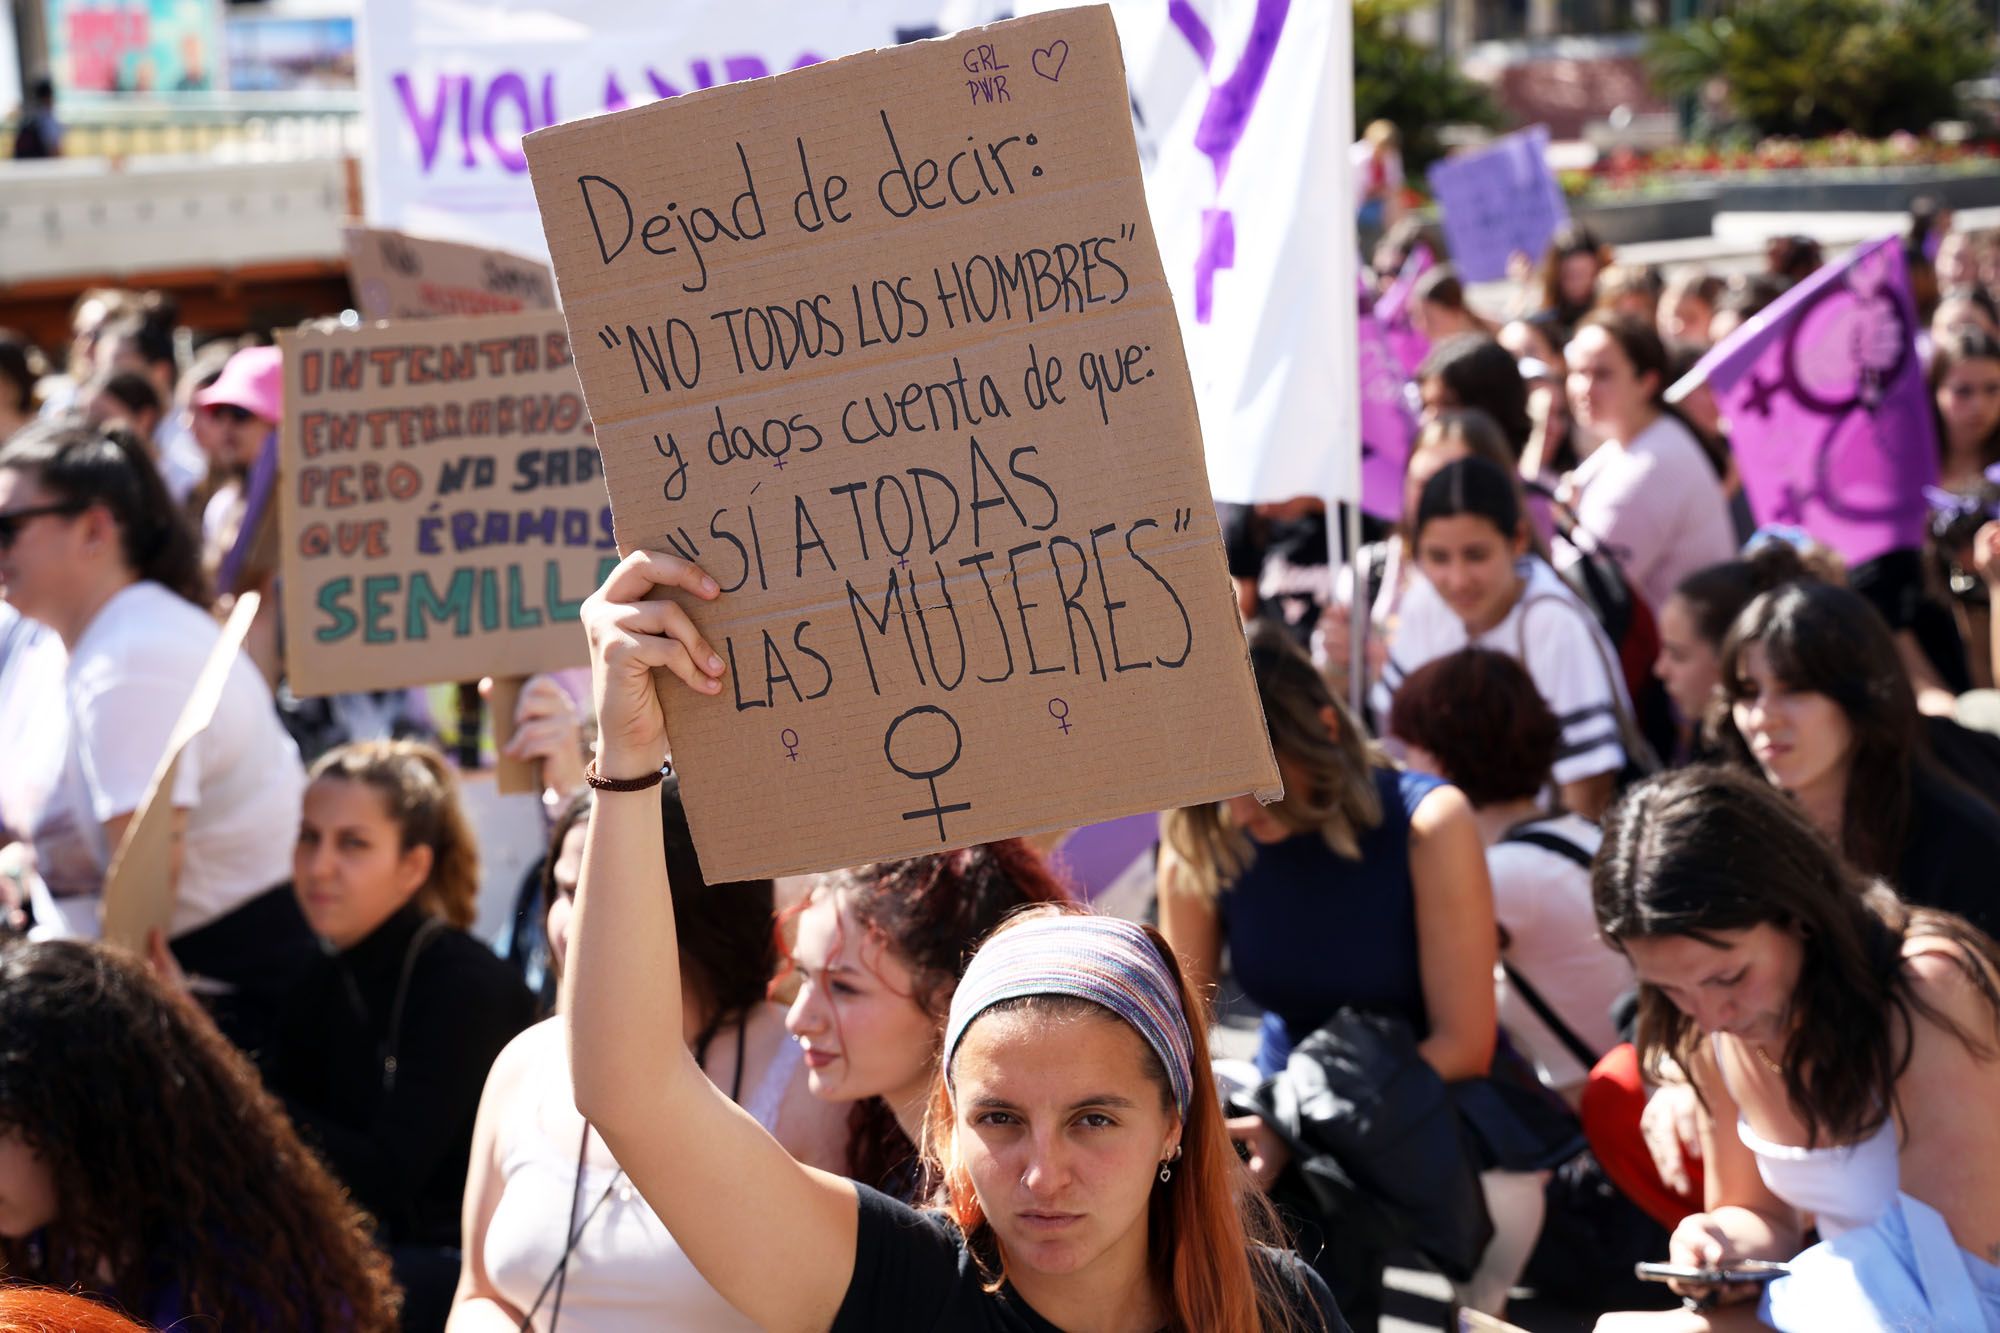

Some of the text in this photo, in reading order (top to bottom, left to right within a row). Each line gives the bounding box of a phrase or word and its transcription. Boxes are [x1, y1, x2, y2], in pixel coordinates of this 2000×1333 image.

[963, 44, 1009, 72] GRL
[966, 75, 1011, 105] PWR
[578, 141, 766, 292] Dejad
[794, 136, 852, 233] de
[878, 110, 1043, 217] decir:
[710, 294, 844, 374] TODOS
[852, 277, 928, 348] LOS
[302, 391, 596, 459] ENTERRARNO
[654, 343, 1154, 501] y daos cuenta de que:
[299, 447, 604, 508] PERO NO SAB
[795, 494, 837, 578] A
[829, 435, 1058, 562] TODAS
[299, 518, 390, 559] QUE
[315, 557, 620, 644] SEMILL
[726, 620, 833, 713] LAS
